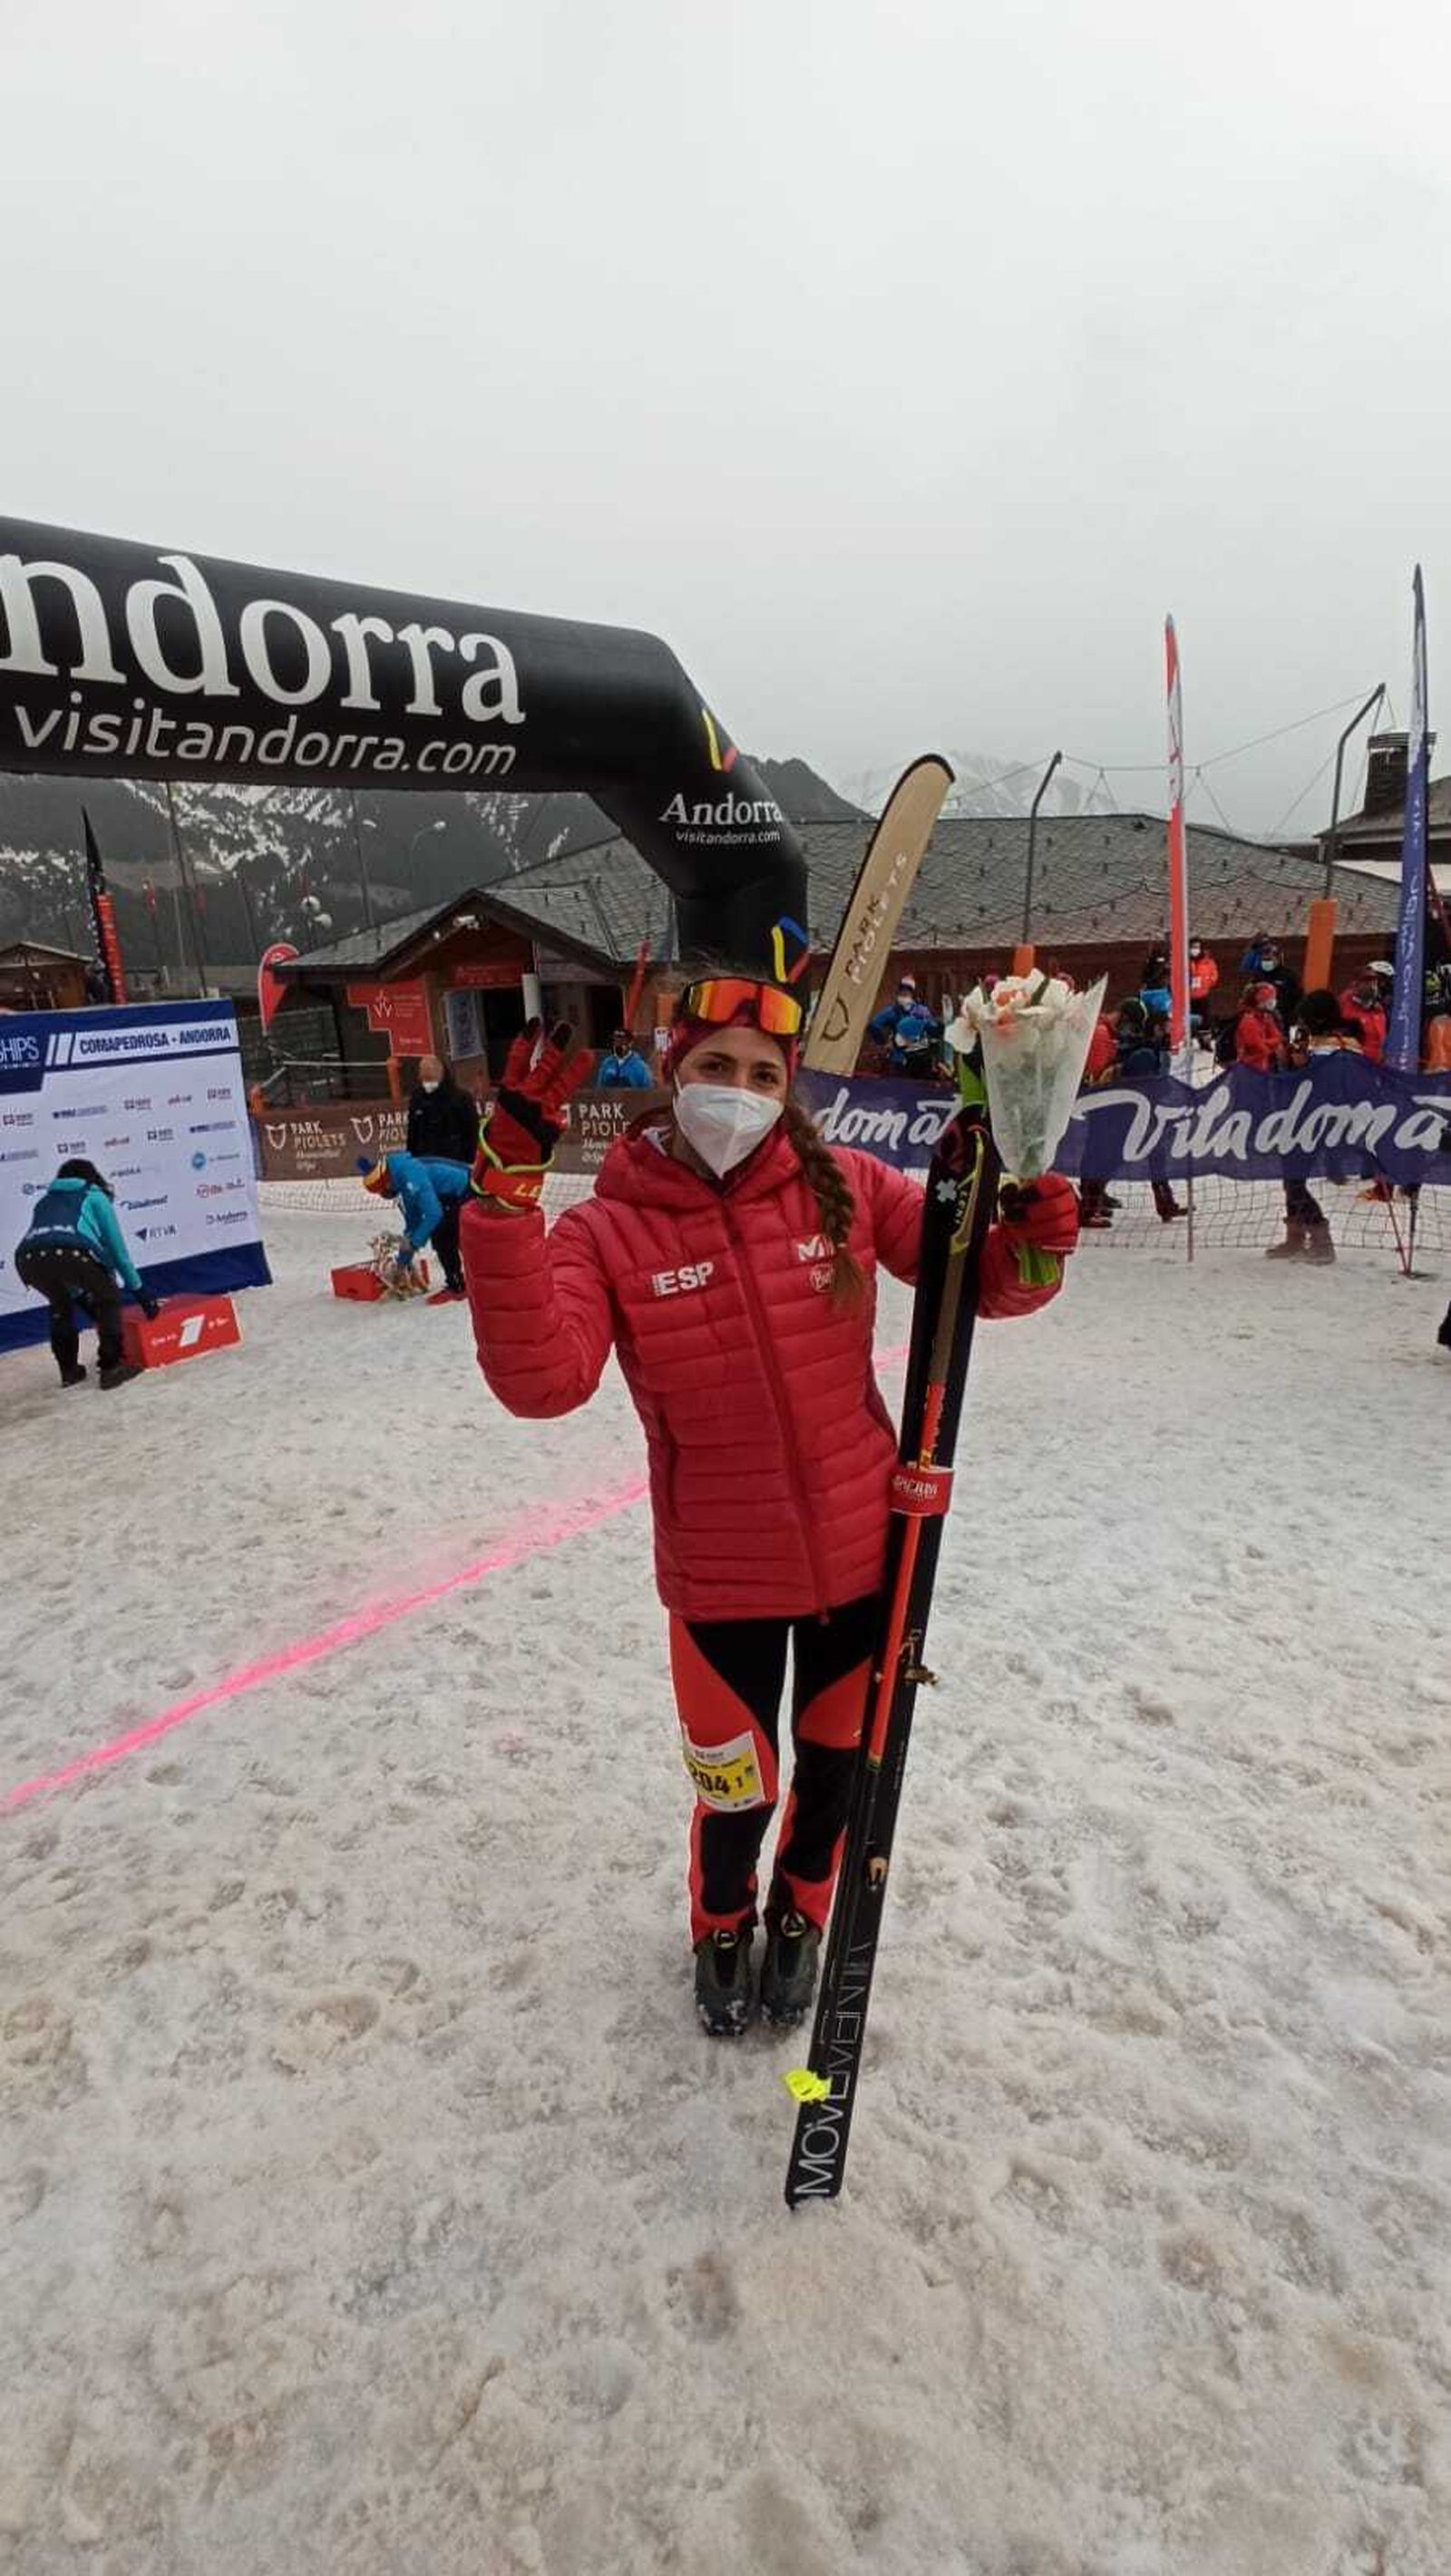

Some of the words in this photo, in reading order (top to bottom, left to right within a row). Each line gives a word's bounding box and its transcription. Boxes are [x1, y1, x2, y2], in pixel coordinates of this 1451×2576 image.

[15, 692, 517, 774] visitandorra.com
[657, 792, 784, 825] Andorra
[676, 831, 781, 845] visitandorra.com
[80, 1034, 169, 1055] COMAPEDROSA
[180, 1026, 231, 1045] ANDORRA
[579, 1103, 625, 1120] PARK
[290, 1120, 323, 1134] PARK
[294, 1133, 347, 1149] PIOLETS
[657, 1261, 714, 1297] ESP
